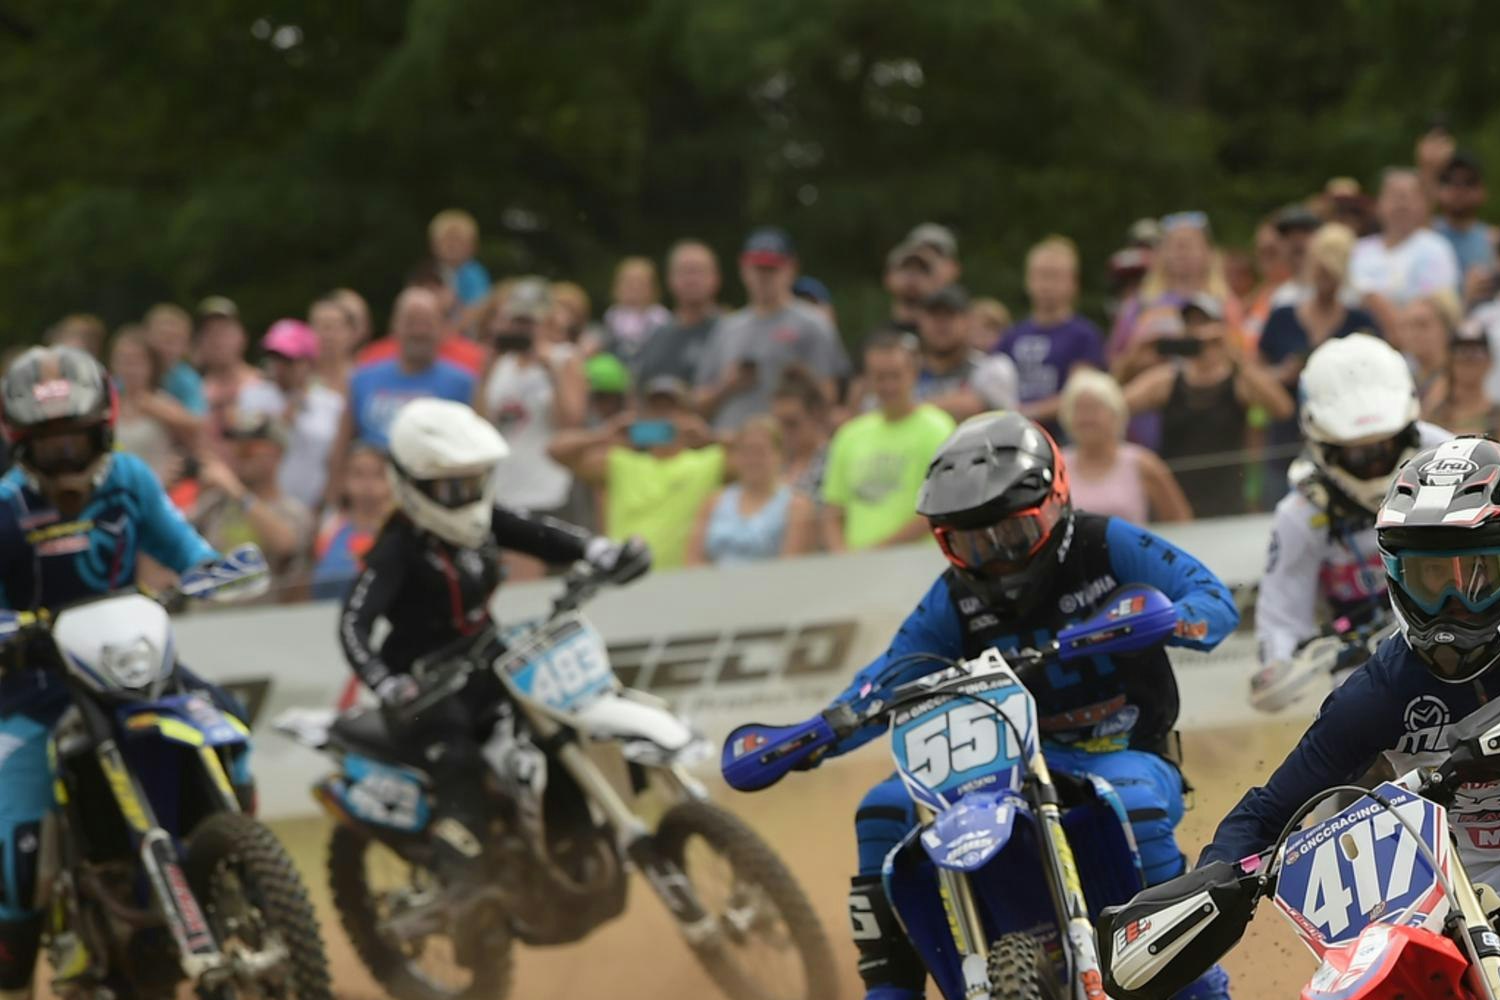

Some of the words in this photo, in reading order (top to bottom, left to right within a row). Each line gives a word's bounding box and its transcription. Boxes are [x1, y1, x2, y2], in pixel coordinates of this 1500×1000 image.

[905, 692, 1027, 788] 551
[1300, 795, 1407, 855] GNCCRACING.OM
[1303, 799, 1425, 938] 417
